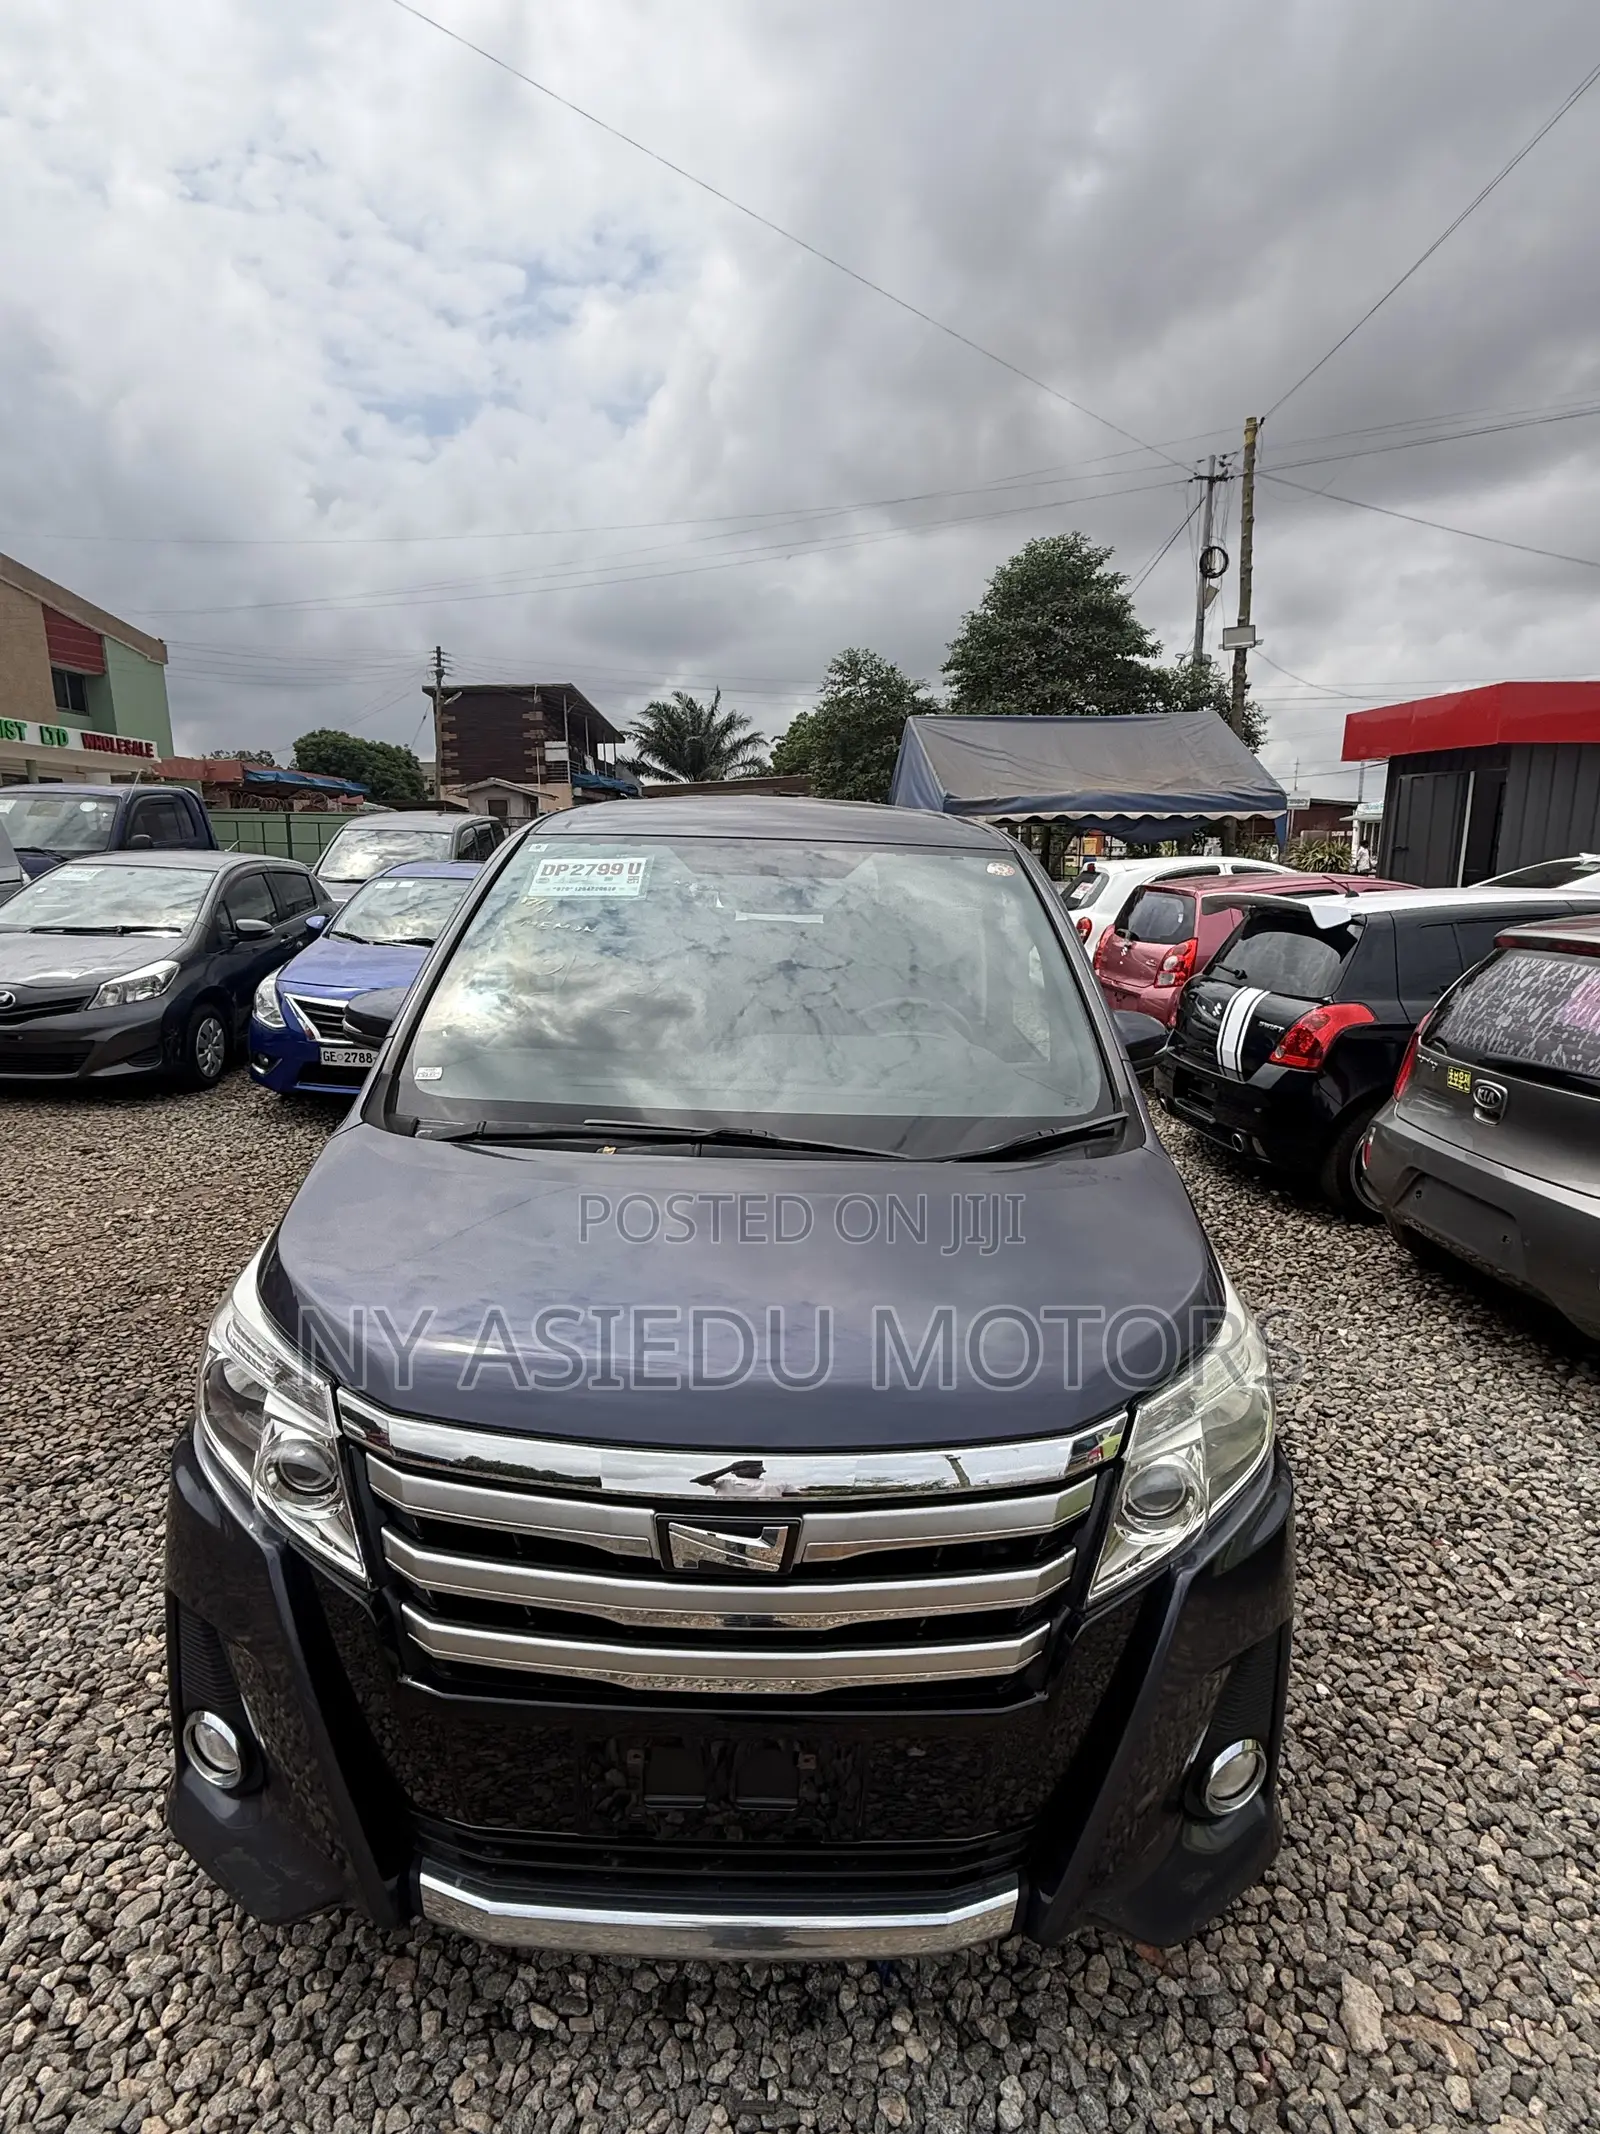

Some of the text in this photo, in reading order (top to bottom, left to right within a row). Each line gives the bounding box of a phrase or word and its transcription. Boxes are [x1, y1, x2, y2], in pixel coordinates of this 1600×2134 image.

[39, 725, 69, 747] LTD
[81, 732, 154, 758] WHOLESALE
[1477, 1088, 1495, 1104] KIA
